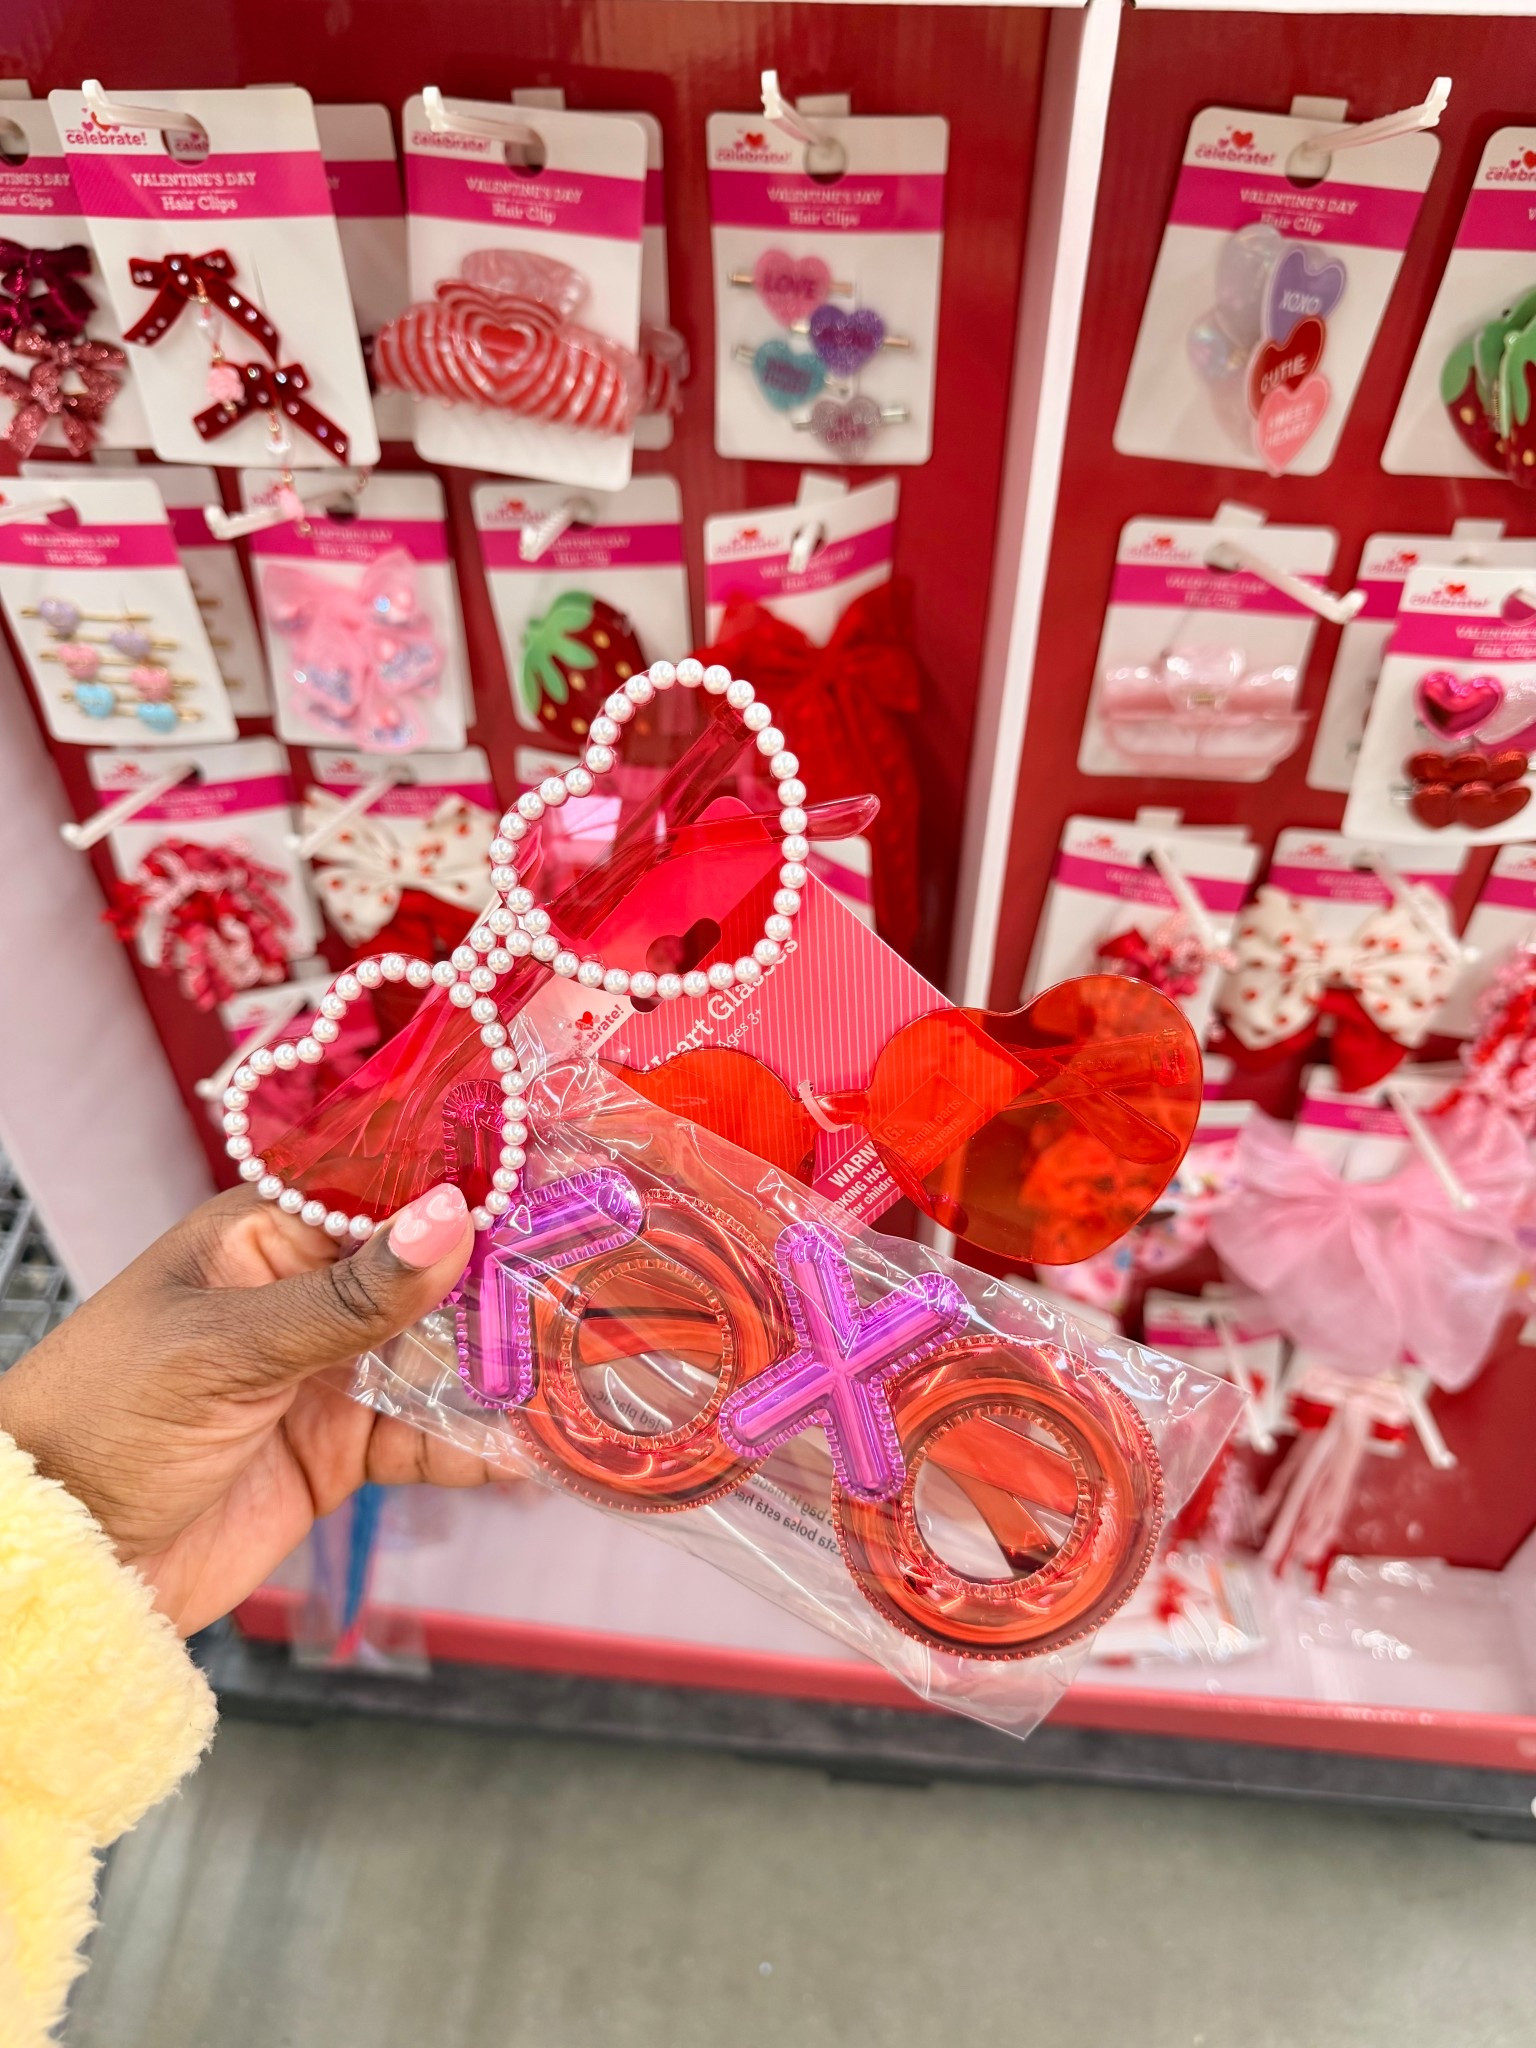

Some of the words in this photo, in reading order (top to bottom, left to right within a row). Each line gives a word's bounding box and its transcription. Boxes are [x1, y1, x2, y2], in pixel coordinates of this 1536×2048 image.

[66, 130, 147, 146] celebrate!
[1195, 147, 1276, 167] celebrate!
[43, 172, 70, 187] DAY
[132, 173, 224, 187] VALENTINE'S
[225, 172, 257, 186] DAY
[466, 177, 552, 201] VALENTINE'S
[554, 188, 583, 204] DAY
[19, 193, 54, 210] Clips
[162, 196, 195, 211] Hair
[197, 196, 238, 213] Clips
[492, 202, 523, 219] Hair
[1240, 188, 1327, 211] VALENTINE'S
[1328, 198, 1359, 215] DAY
[1279, 288, 1323, 314] XOXO
[1260, 353, 1308, 393] CUTIE
[715, 1022, 749, 1048] Ages
[747, 1008, 762, 1025] 3+
[848, 1201, 865, 1217] for
[928, 1140, 936, 1150] 3
